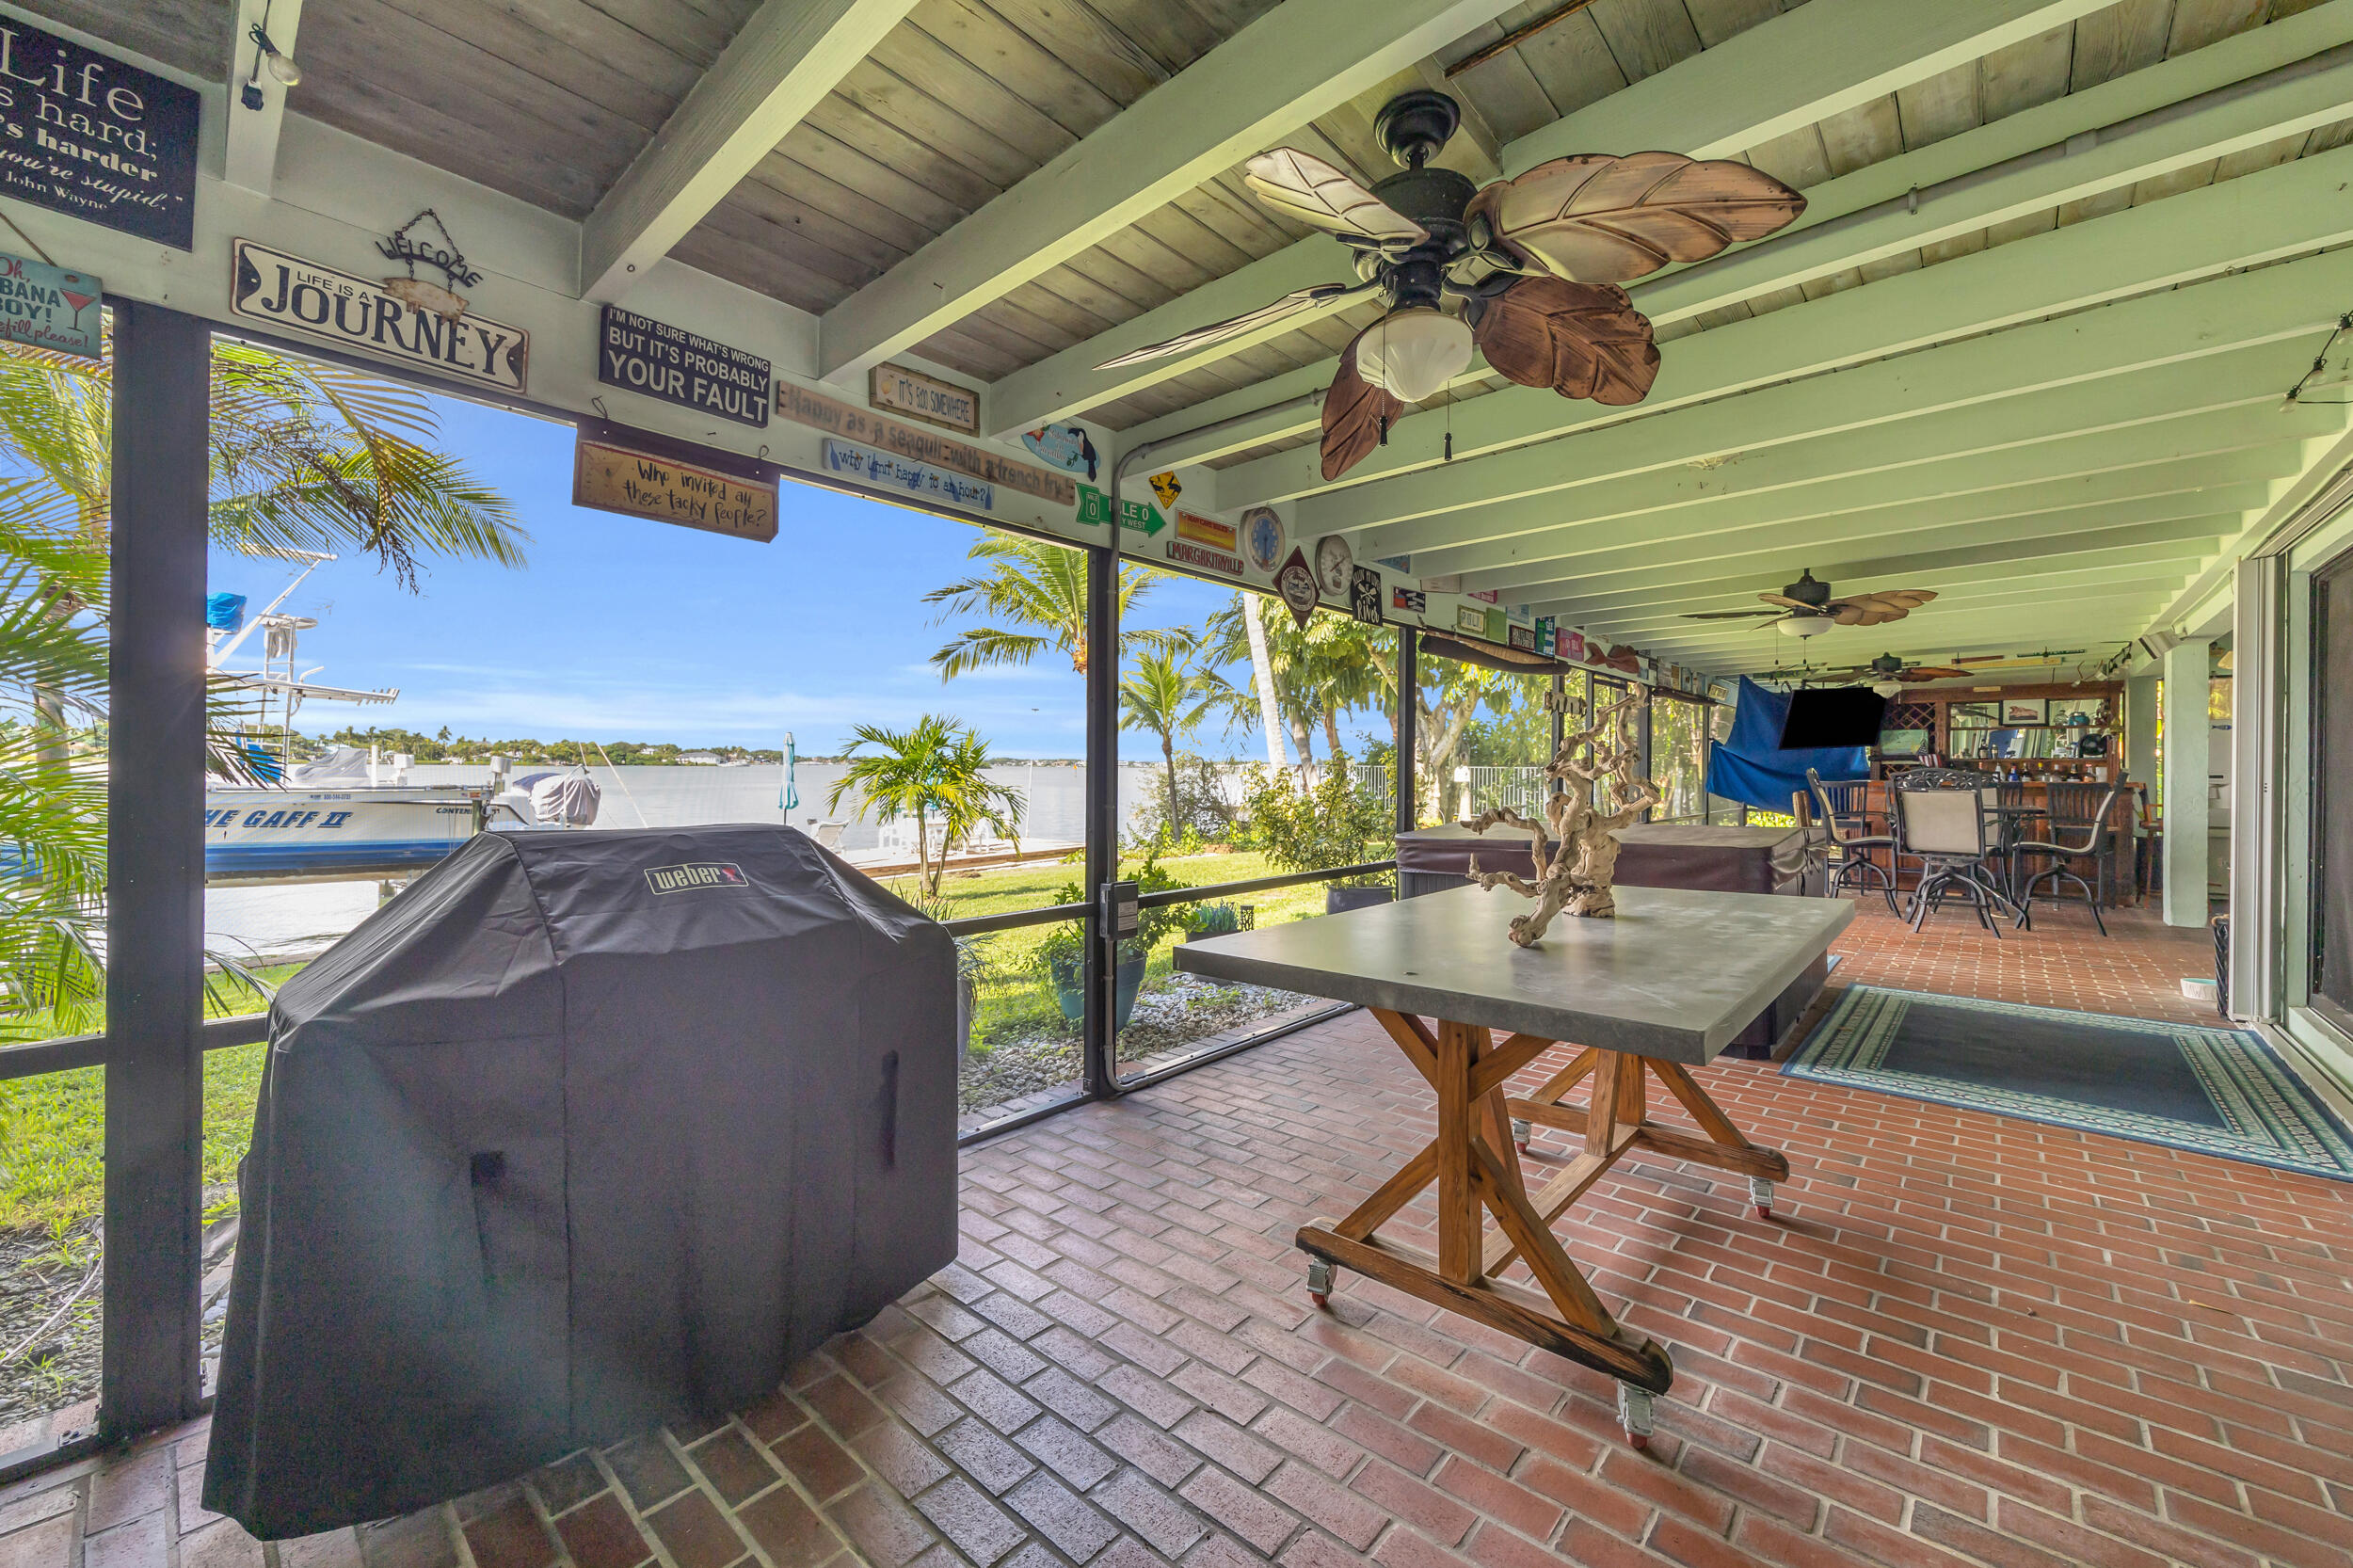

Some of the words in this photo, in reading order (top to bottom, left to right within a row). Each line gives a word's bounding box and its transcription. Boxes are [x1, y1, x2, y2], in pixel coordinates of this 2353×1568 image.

[0, 27, 144, 121] Life
[35, 93, 157, 162] hard;
[37, 127, 158, 182] harder
[6, 171, 47, 193] John
[54, 185, 108, 210] Wayne
[0, 256, 30, 283] Oh,
[375, 236, 484, 288] WELCOME
[296, 271, 333, 291] LIFE
[339, 282, 354, 297] IS
[359, 291, 370, 302] A
[34, 325, 89, 348] please!
[261, 264, 507, 376] JOURNEY
[609, 308, 626, 324] I'M
[629, 313, 653, 332] NOT
[656, 323, 686, 344] SURE
[688, 334, 728, 359] WHAT'S
[730, 349, 769, 373] WRONG
[609, 326, 646, 353] BUT
[649, 340, 680, 364] IT'S
[684, 351, 768, 392] PROBABLY
[608, 349, 686, 399] YOUR
[693, 376, 768, 423] FAULT
[899, 379, 913, 407] IT'S
[930, 391, 970, 424] SOMEWHERE
[847, 412, 866, 433] as
[873, 420, 885, 440] a
[950, 446, 981, 474] with
[636, 460, 670, 487] Who
[680, 472, 727, 501] invited
[735, 490, 752, 508] all
[839, 450, 863, 471] why
[896, 464, 926, 490] happy
[929, 472, 939, 488] to
[943, 480, 956, 495] an
[958, 481, 986, 502] hour?
[623, 479, 663, 506] these
[666, 488, 707, 520] tacky
[1089, 502, 1096, 516] 0
[1142, 507, 1149, 520] 0
[1127, 518, 1146, 530] WEST
[242, 809, 320, 829] GAFF
[317, 811, 354, 829] II
[653, 865, 723, 889] weber
